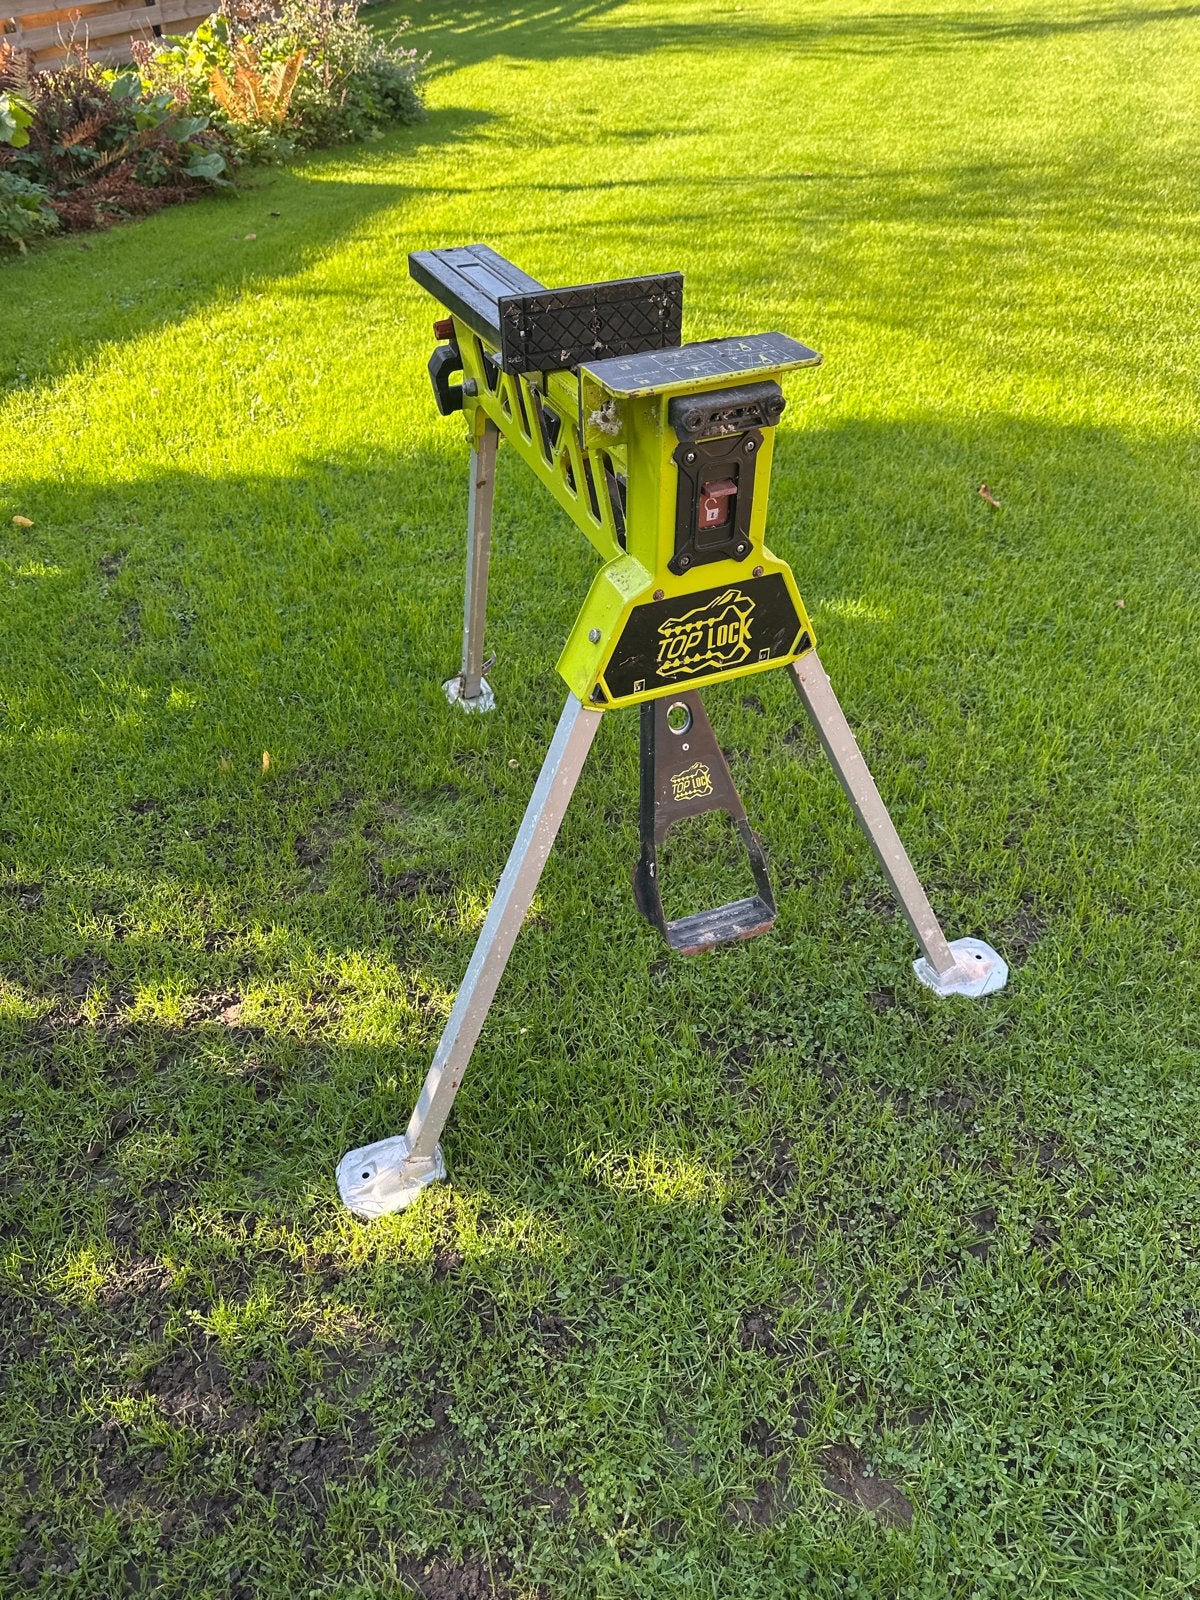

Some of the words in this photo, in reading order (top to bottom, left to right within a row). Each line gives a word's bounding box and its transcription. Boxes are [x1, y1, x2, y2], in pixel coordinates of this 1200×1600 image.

[657, 631, 703, 662] TOP
[707, 617, 754, 649] LOCK
[672, 780, 690, 794] TOP
[692, 773, 712, 788] LOCK
